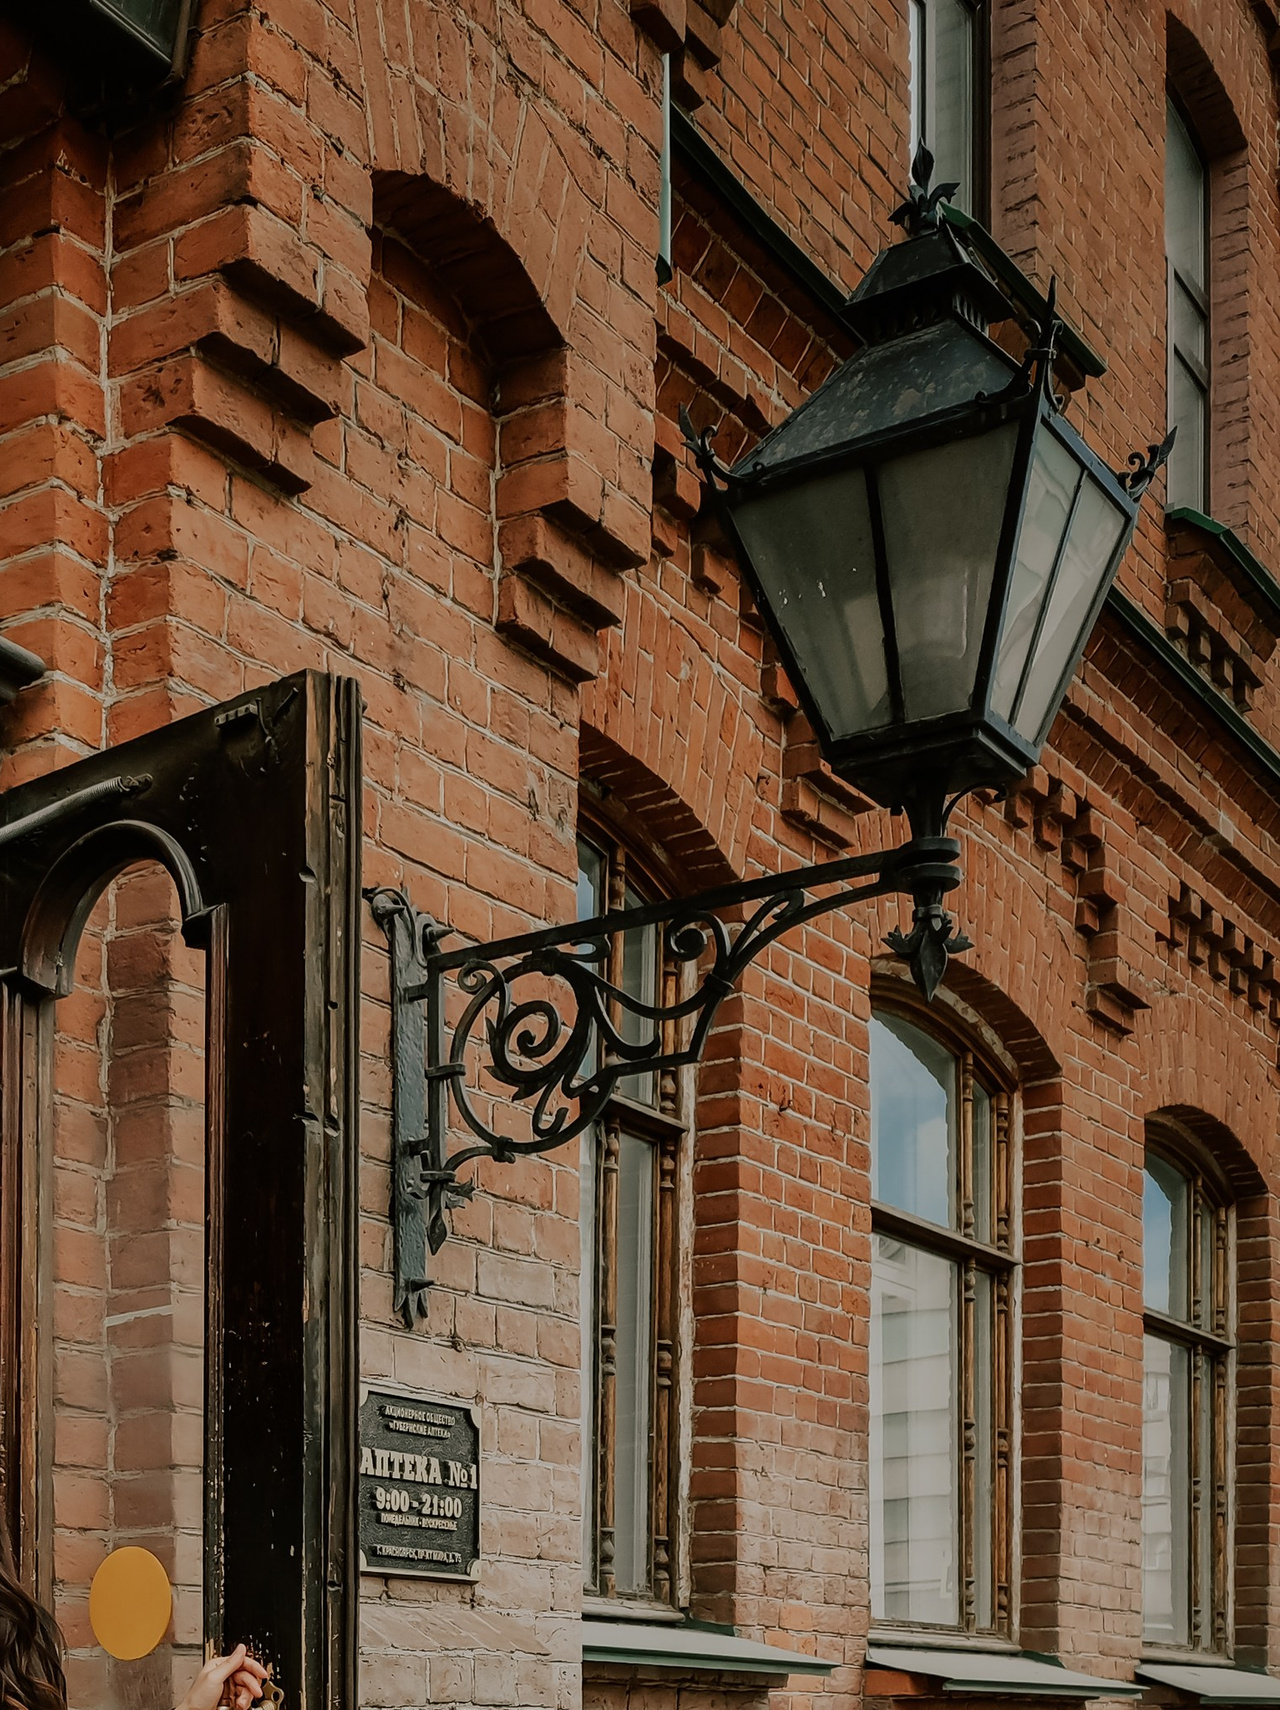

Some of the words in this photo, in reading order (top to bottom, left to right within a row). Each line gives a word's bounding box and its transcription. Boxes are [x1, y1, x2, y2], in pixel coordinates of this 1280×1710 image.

[426, 1412, 456, 1426] ОБЩЕСТВО
[360, 1446, 442, 1484] АПТЕКА
[446, 1460, 477, 1489] №1
[375, 1486, 410, 1513] 9:00
[421, 1492, 462, 1519] 21:00
